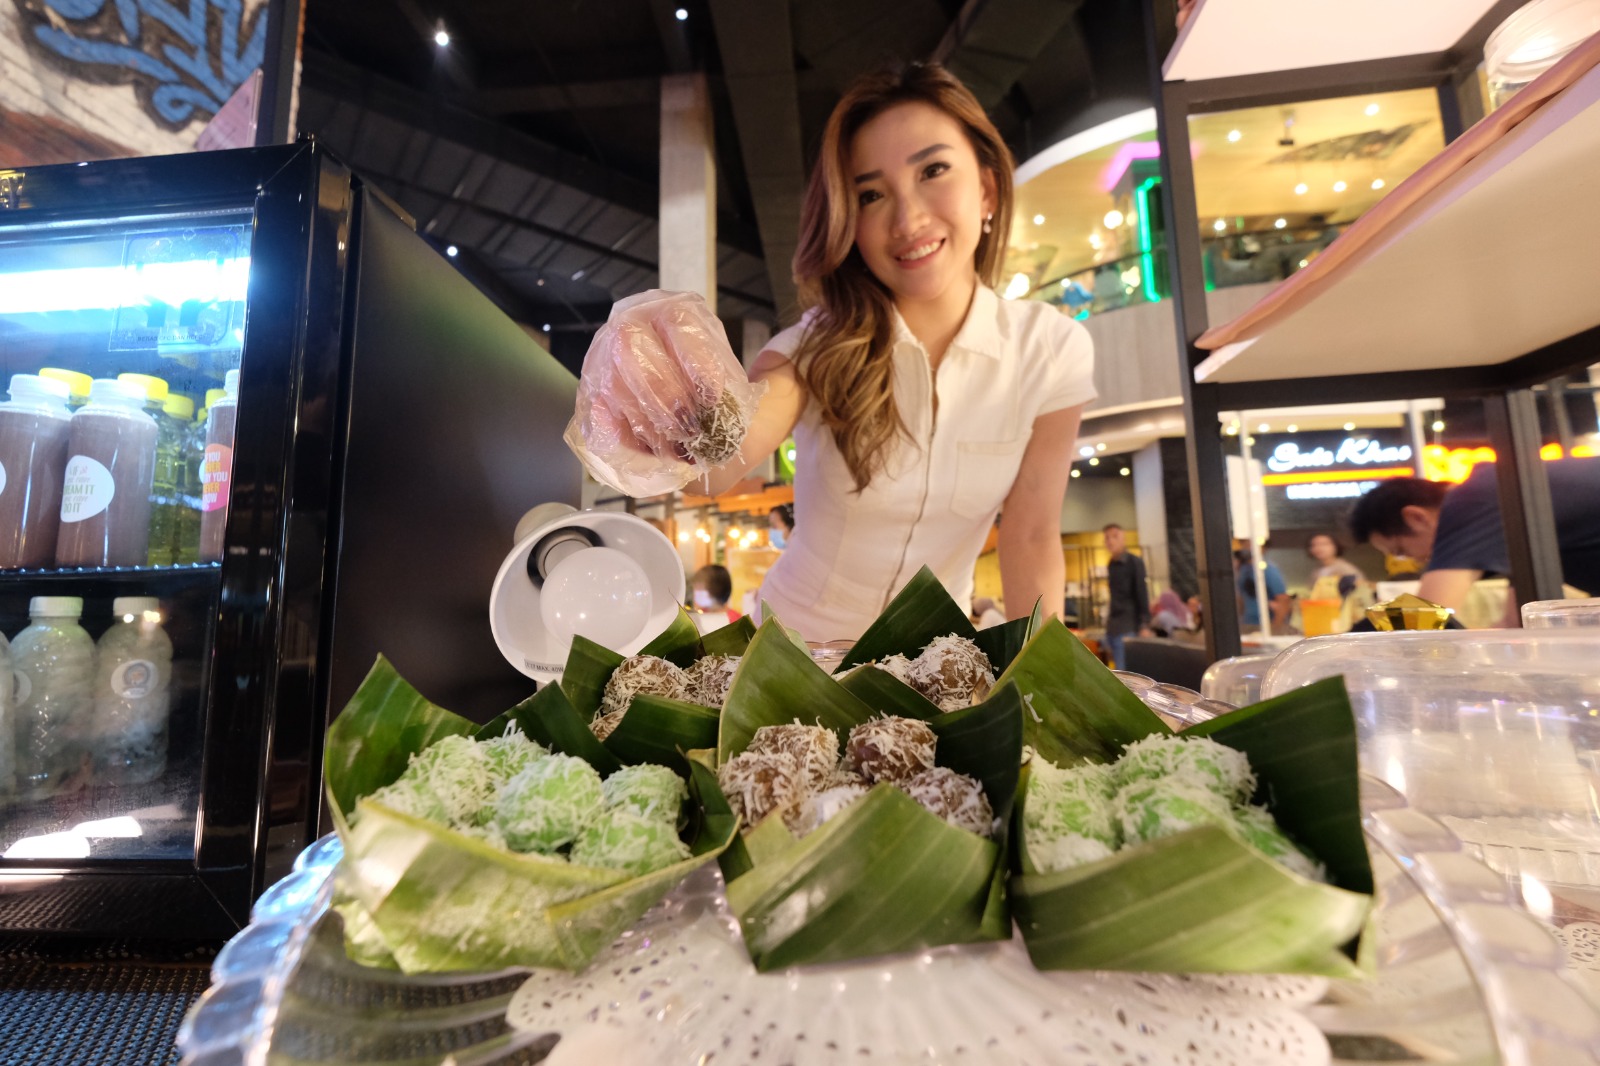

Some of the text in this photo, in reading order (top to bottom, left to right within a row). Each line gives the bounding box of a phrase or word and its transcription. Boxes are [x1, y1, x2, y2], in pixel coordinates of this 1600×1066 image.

[213, 471, 228, 482] YOU
[85, 484, 96, 495] IT
[73, 502, 82, 513] IT
